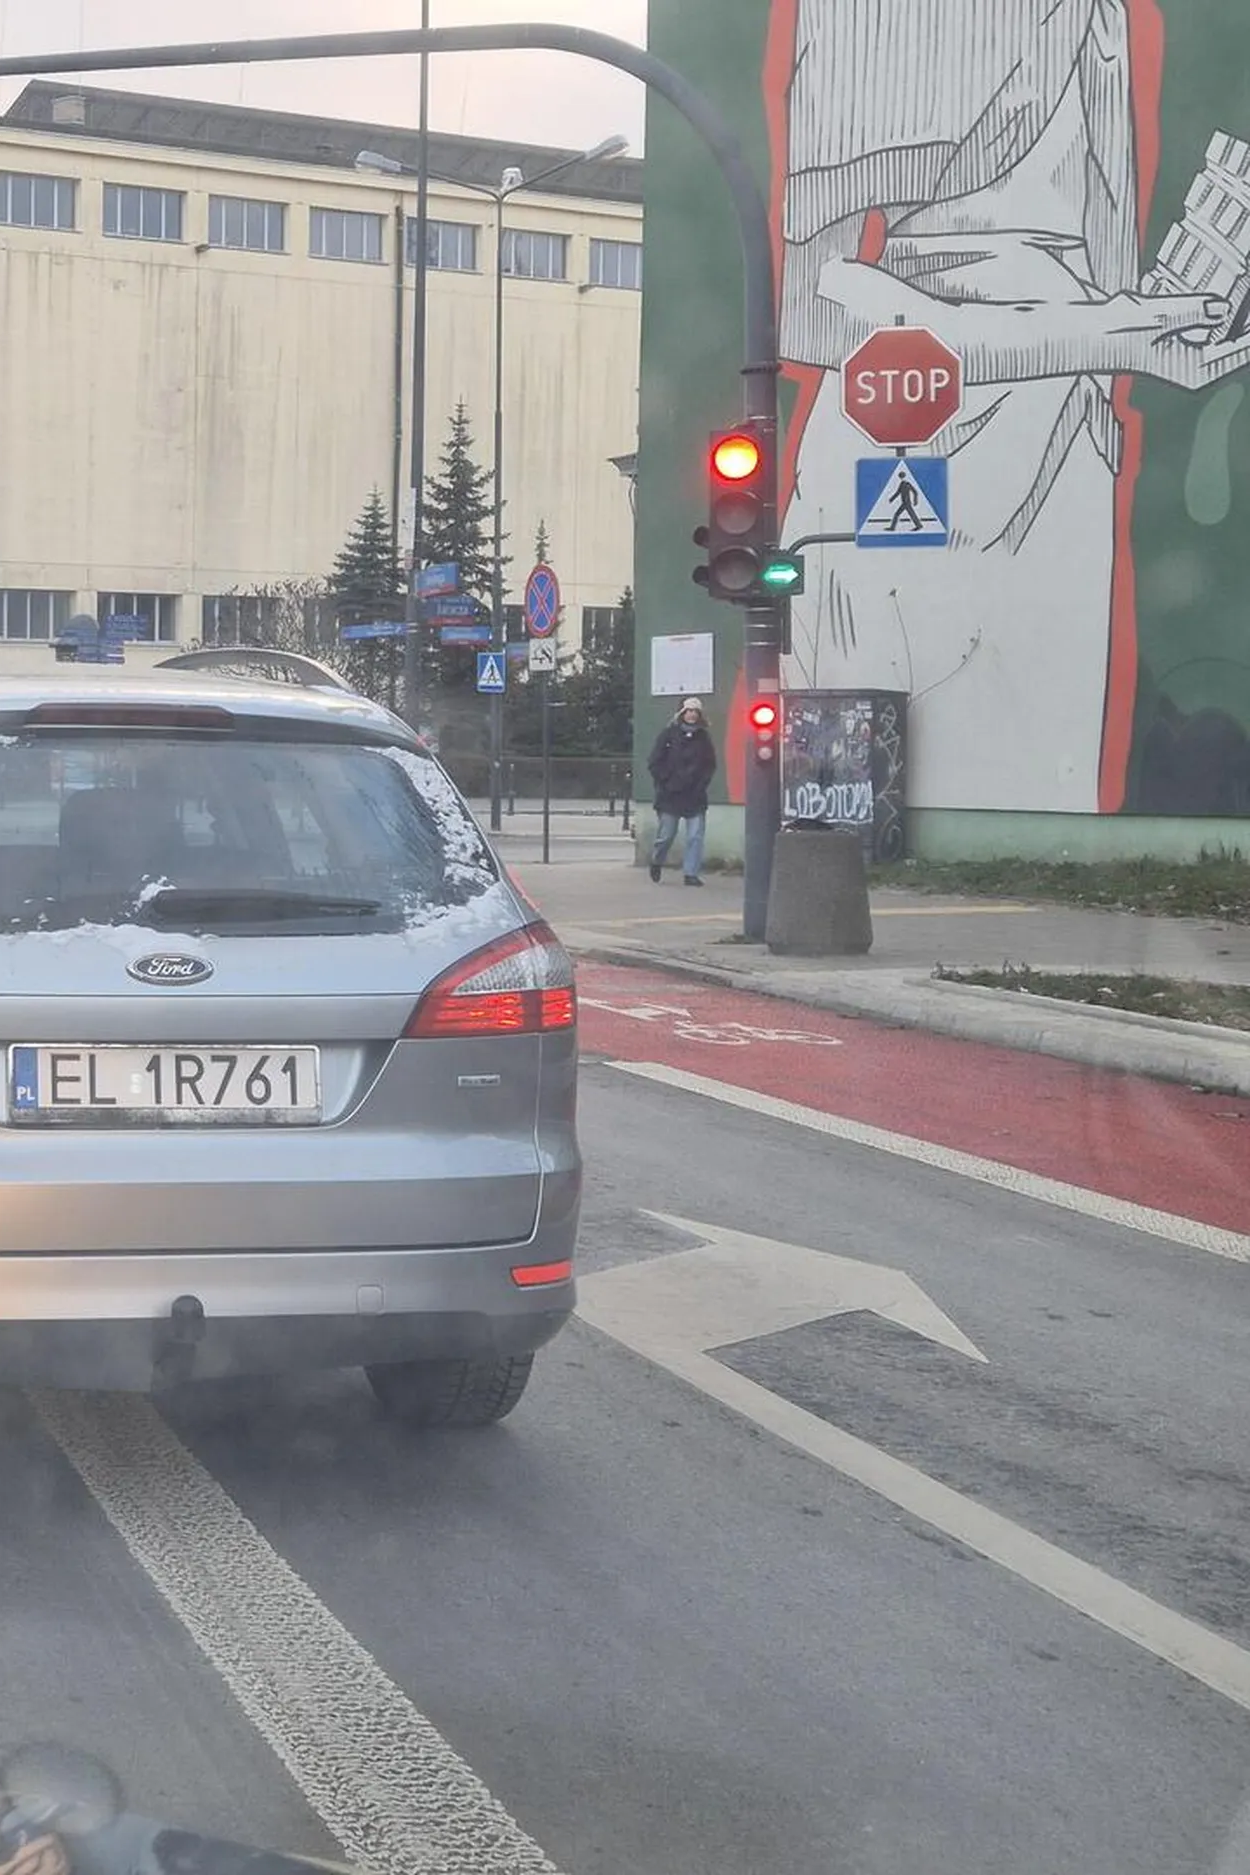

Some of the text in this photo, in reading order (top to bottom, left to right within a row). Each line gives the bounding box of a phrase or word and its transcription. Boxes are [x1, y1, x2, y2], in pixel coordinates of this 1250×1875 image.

[856, 367, 950, 404] STOP
[148, 957, 194, 975] Ford
[51, 1053, 298, 1105] EL 1R761
[16, 1086, 36, 1101] PL
